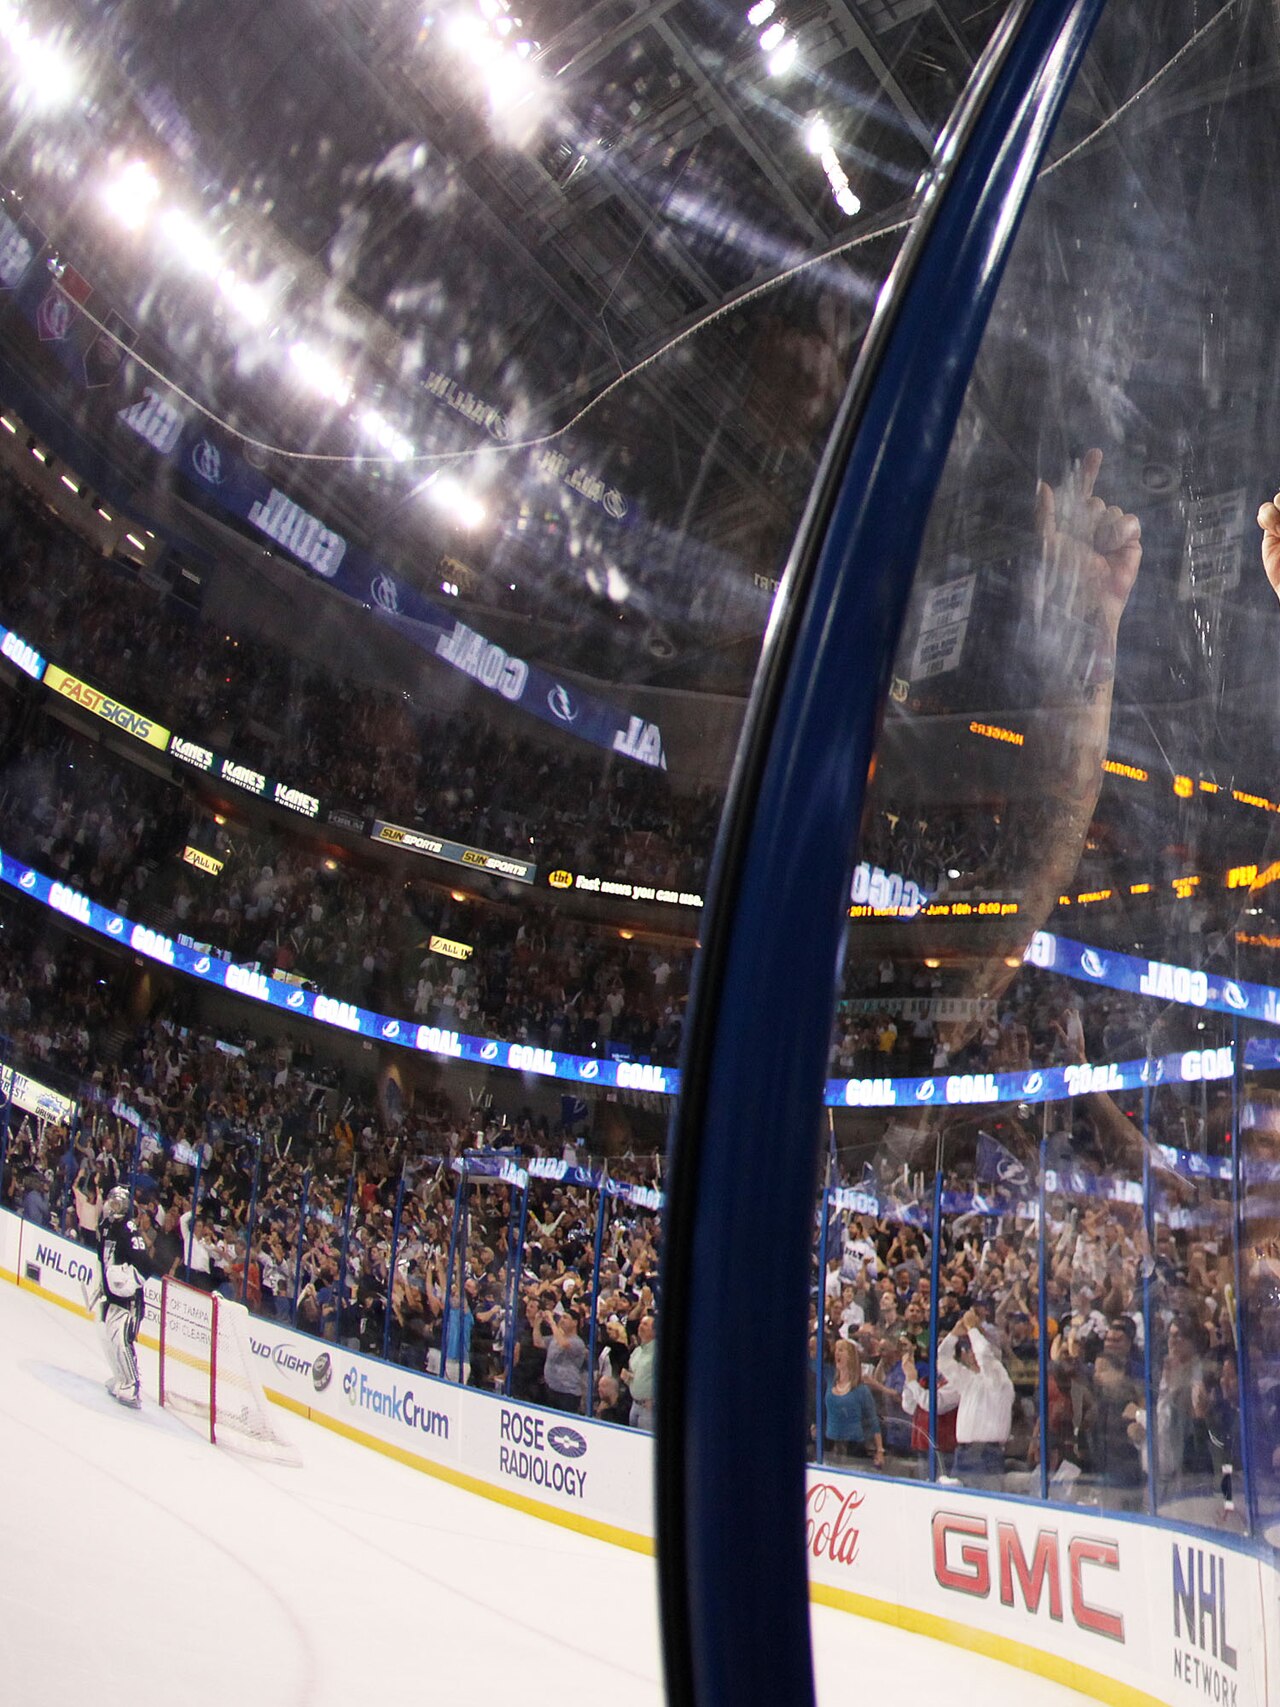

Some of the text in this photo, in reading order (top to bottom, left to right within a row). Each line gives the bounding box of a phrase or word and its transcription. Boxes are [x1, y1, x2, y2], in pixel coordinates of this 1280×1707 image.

[1, 632, 40, 681] GOAL
[58, 677, 153, 739] FASTSIGNS
[171, 735, 214, 768] KANE'S
[171, 751, 208, 770] FURNITURE
[222, 759, 266, 790] KANE'S
[222, 774, 261, 795] FURNITURE
[275, 783, 320, 813] KANE'S
[275, 798, 315, 818] FURNITURE
[382, 828, 442, 853] SUN SPORTS
[195, 855, 210, 869] ALL
[463, 852, 527, 877] SUN SPORTS
[553, 872, 569, 884] tbt
[575, 875, 600, 891] Fast
[631, 886, 655, 900] you
[656, 890, 678, 903] can
[49, 882, 91, 925] GOAL
[850, 905, 872, 917] 2011
[926, 904, 949, 916] June
[1001, 903, 1018, 916] pm
[1077, 889, 1112, 904] PENALTY
[131, 924, 175, 965] GOAL
[442, 943, 458, 955] ALL
[225, 963, 270, 1001] GOAL
[313, 994, 361, 1032] GOAL
[416, 1025, 462, 1057] GOAL
[508, 1043, 556, 1076] GOAL
[616, 1062, 666, 1092] GOAL
[946, 1074, 999, 1104] GOAL
[846, 1079, 896, 1106] GOAL
[130, 1236, 146, 1250] 35
[276, 1349, 312, 1376] LIGHT
[360, 1374, 449, 1440] FrankCrum
[500, 1409, 545, 1451] ROSE
[500, 1446, 587, 1498] RADIOLOGY
[931, 1510, 1126, 1644] GMC
[1172, 1542, 1238, 1671] NHL
[1173, 1648, 1238, 1707] NETWORK
